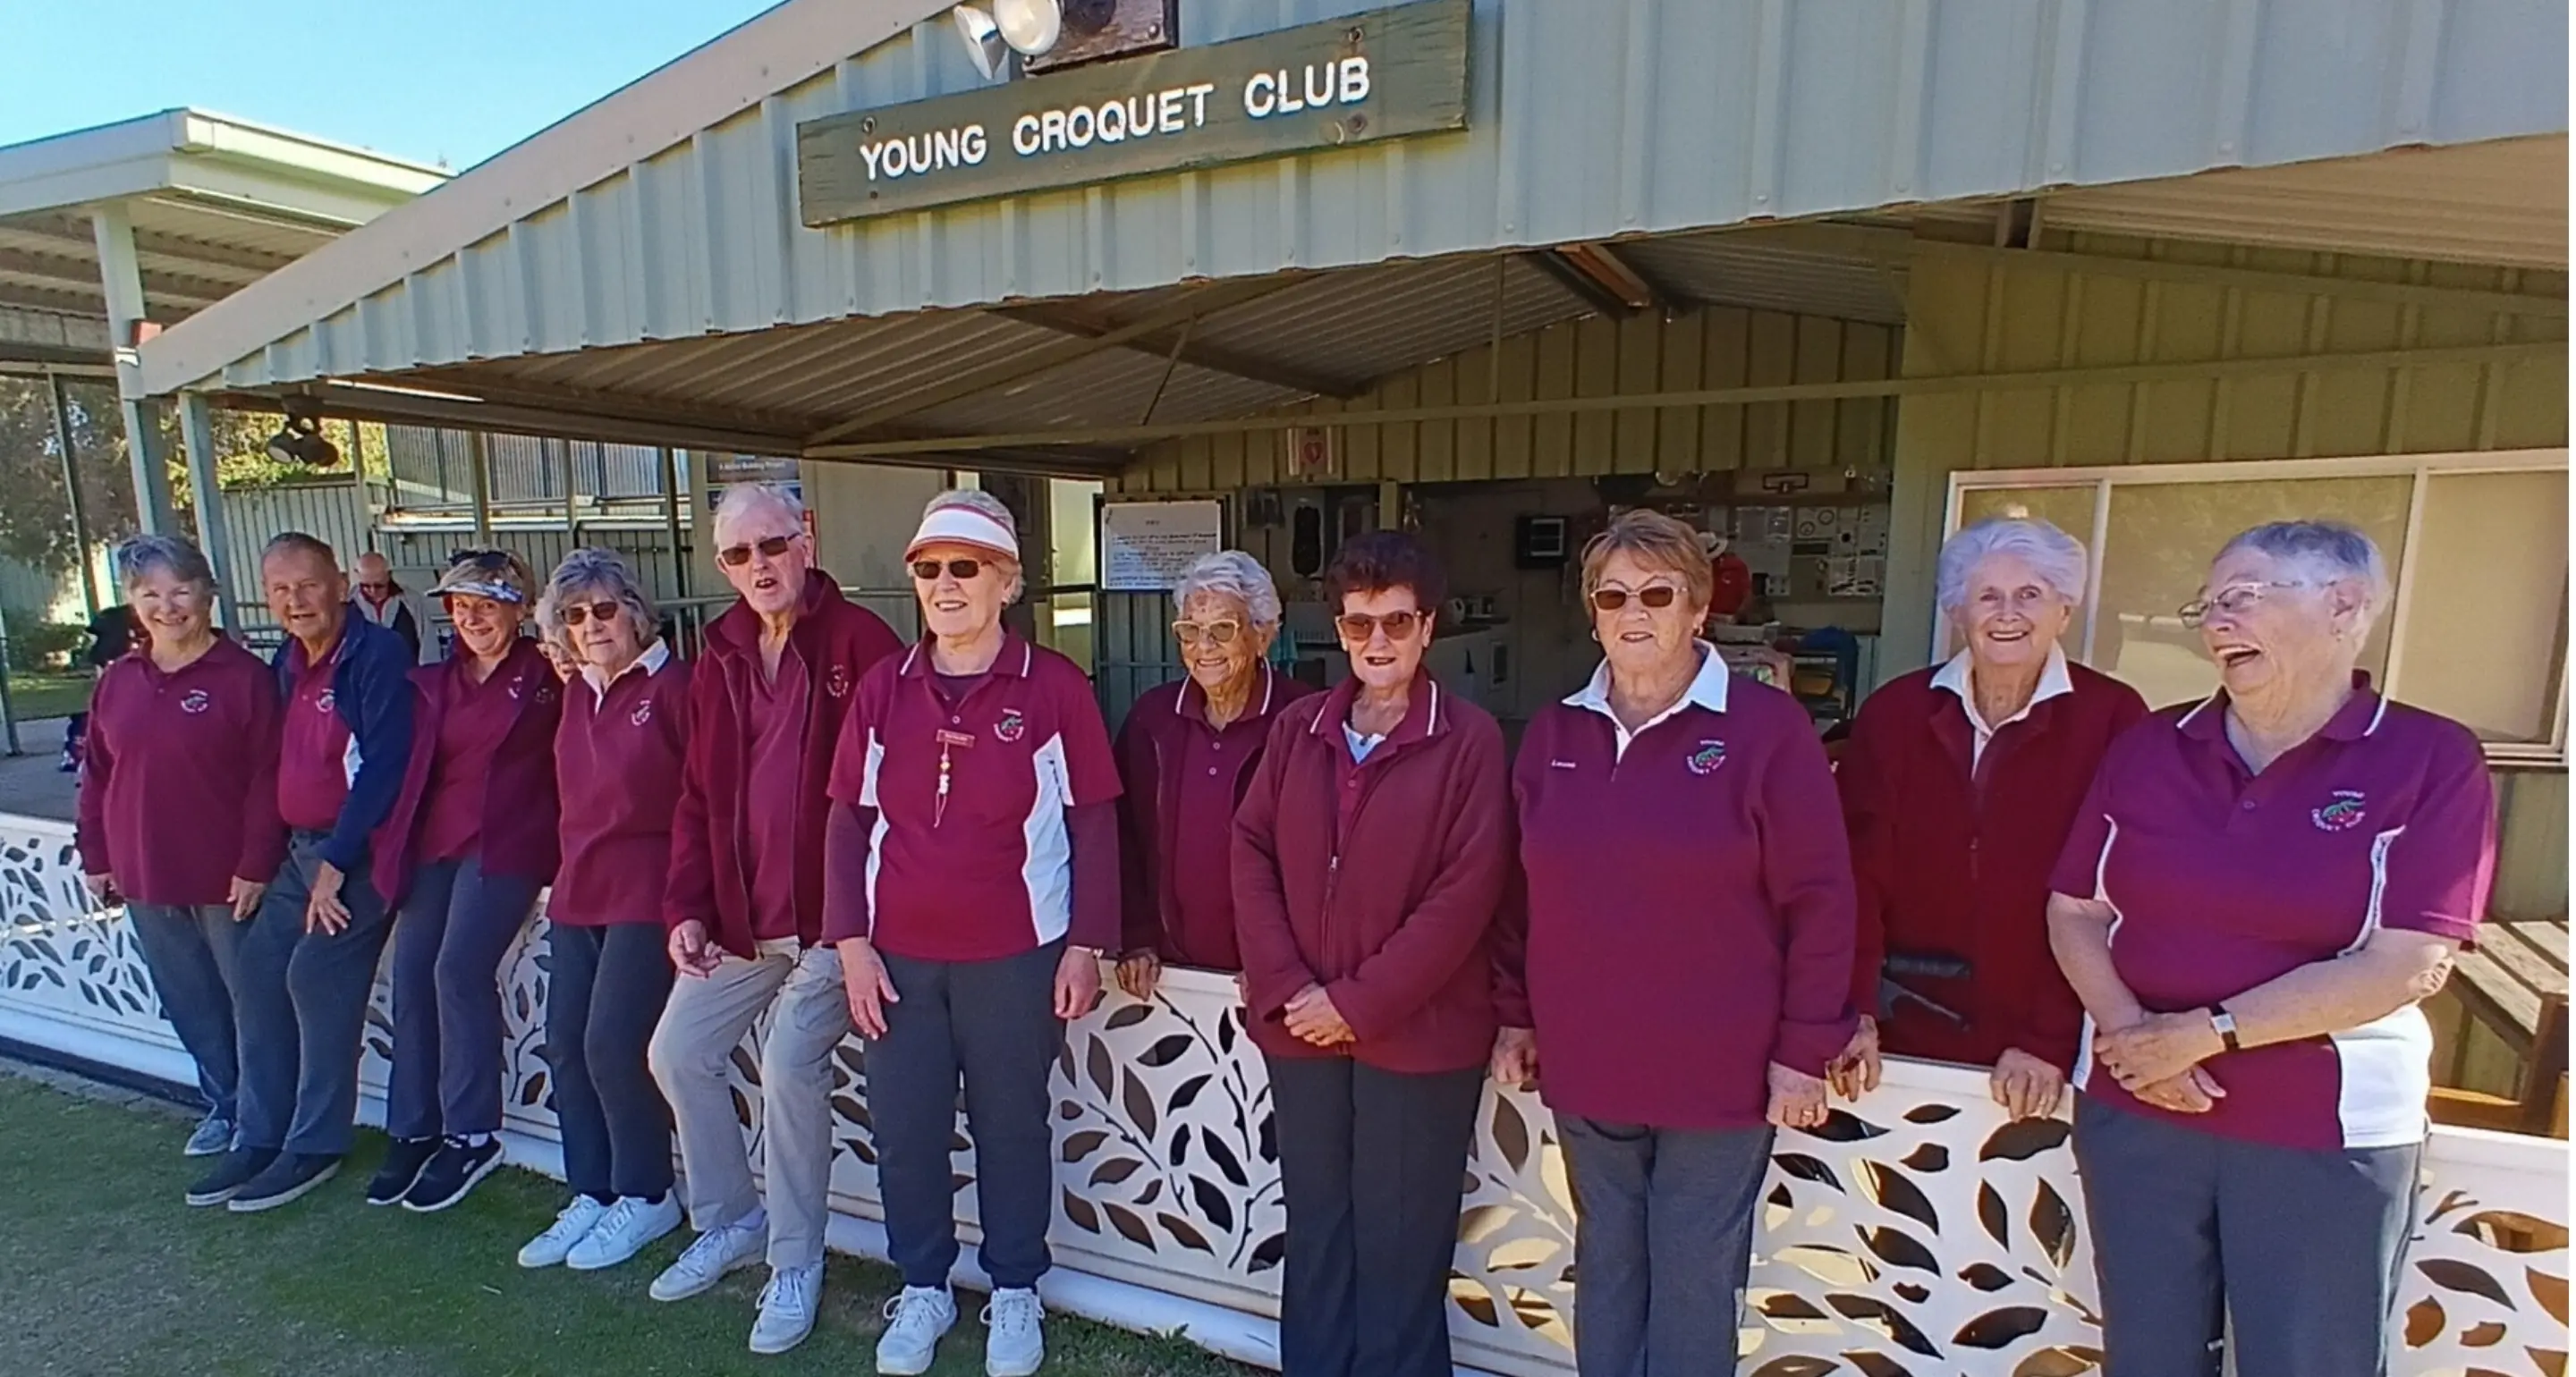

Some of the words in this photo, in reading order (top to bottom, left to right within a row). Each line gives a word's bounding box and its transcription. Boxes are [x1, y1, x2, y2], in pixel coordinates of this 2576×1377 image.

[859, 124, 987, 181] YOUNG
[1012, 83, 1215, 156] CROQUET
[1244, 56, 1370, 117] CLUB
